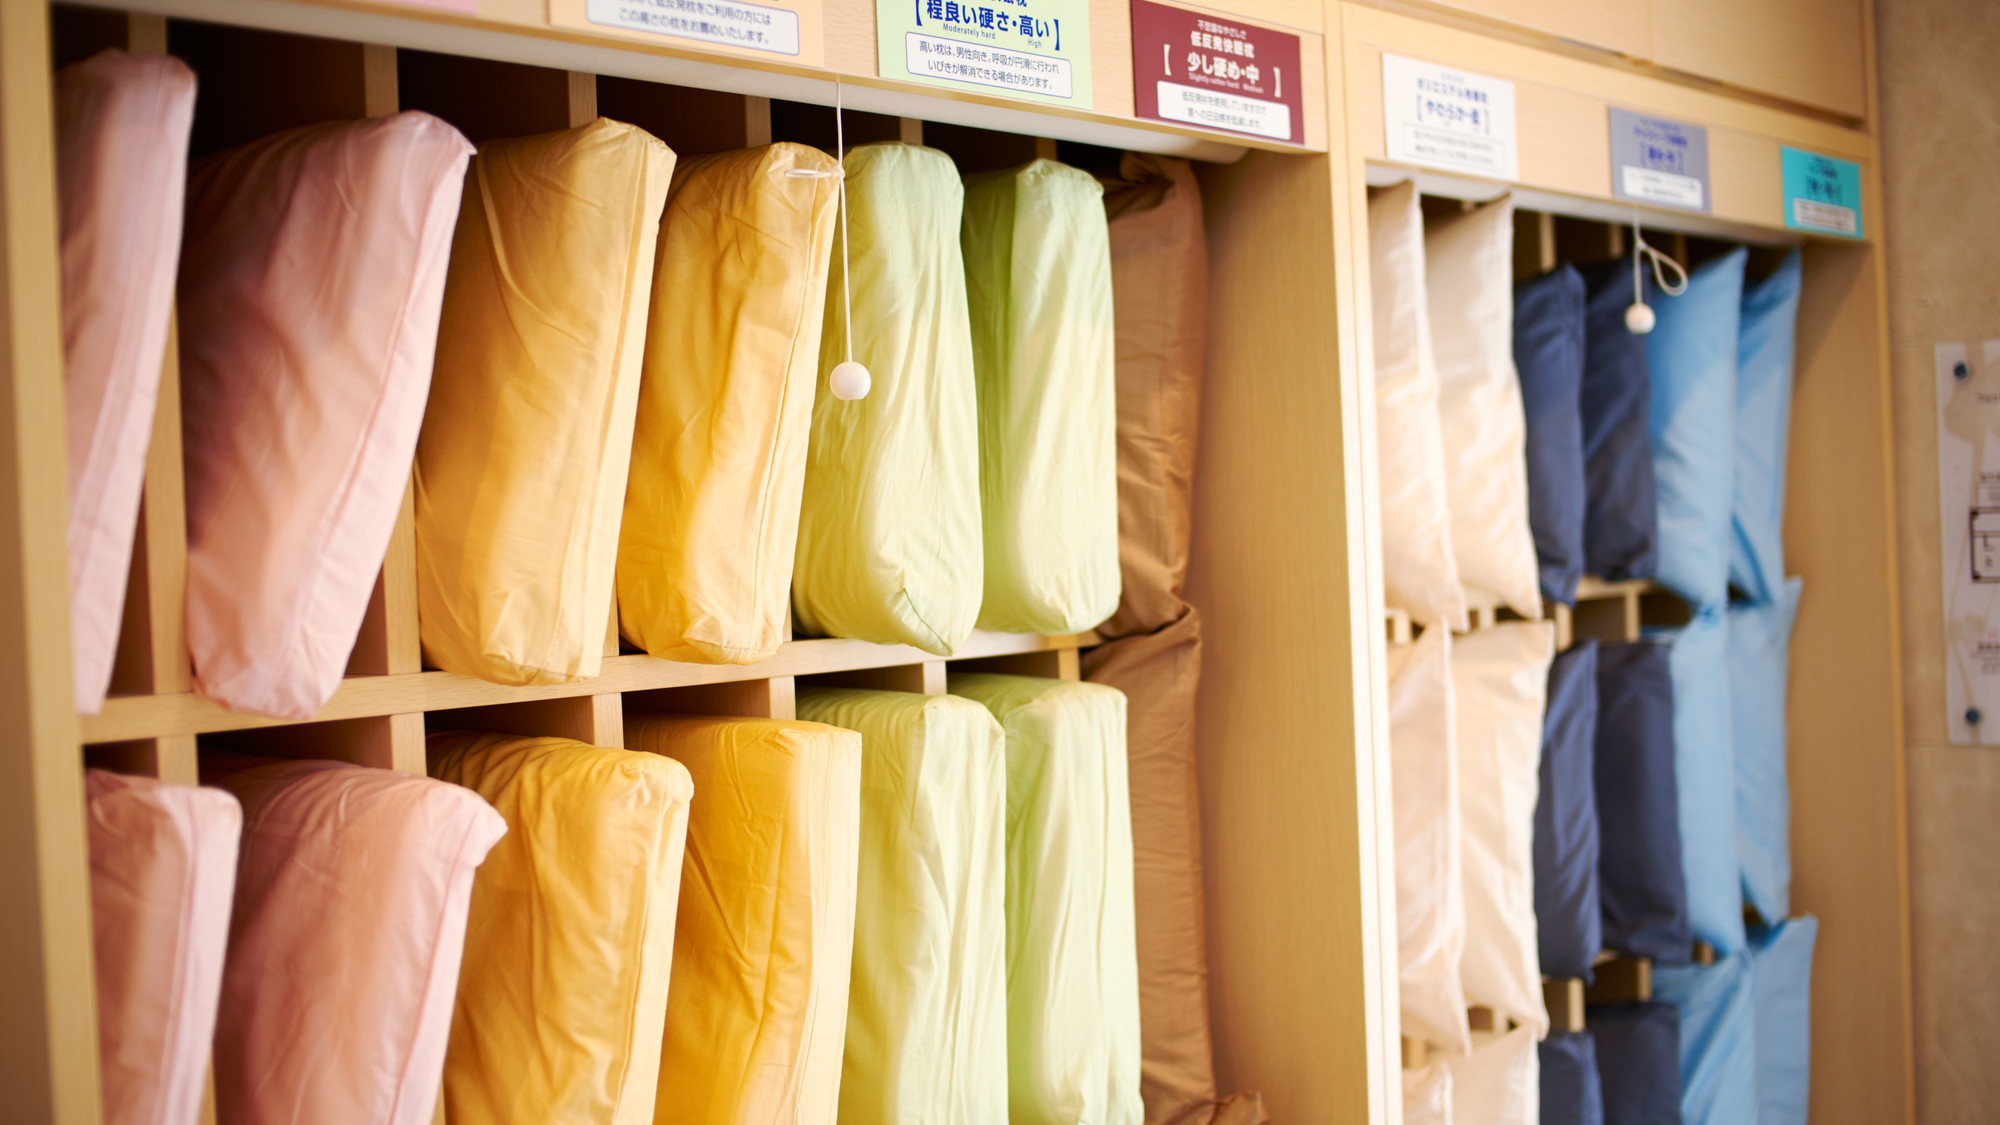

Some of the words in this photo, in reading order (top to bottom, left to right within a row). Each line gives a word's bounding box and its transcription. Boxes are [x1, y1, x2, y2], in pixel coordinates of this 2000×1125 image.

[943, 23, 980, 38] Moderately
[981, 31, 996, 40] hard
[1027, 39, 1042, 49] High
[919, 40, 1060, 74] 高い枕は、男性向き。呼吸が円滑に行われ
[928, 60, 1053, 90] いびきが解消できる場合があります。
